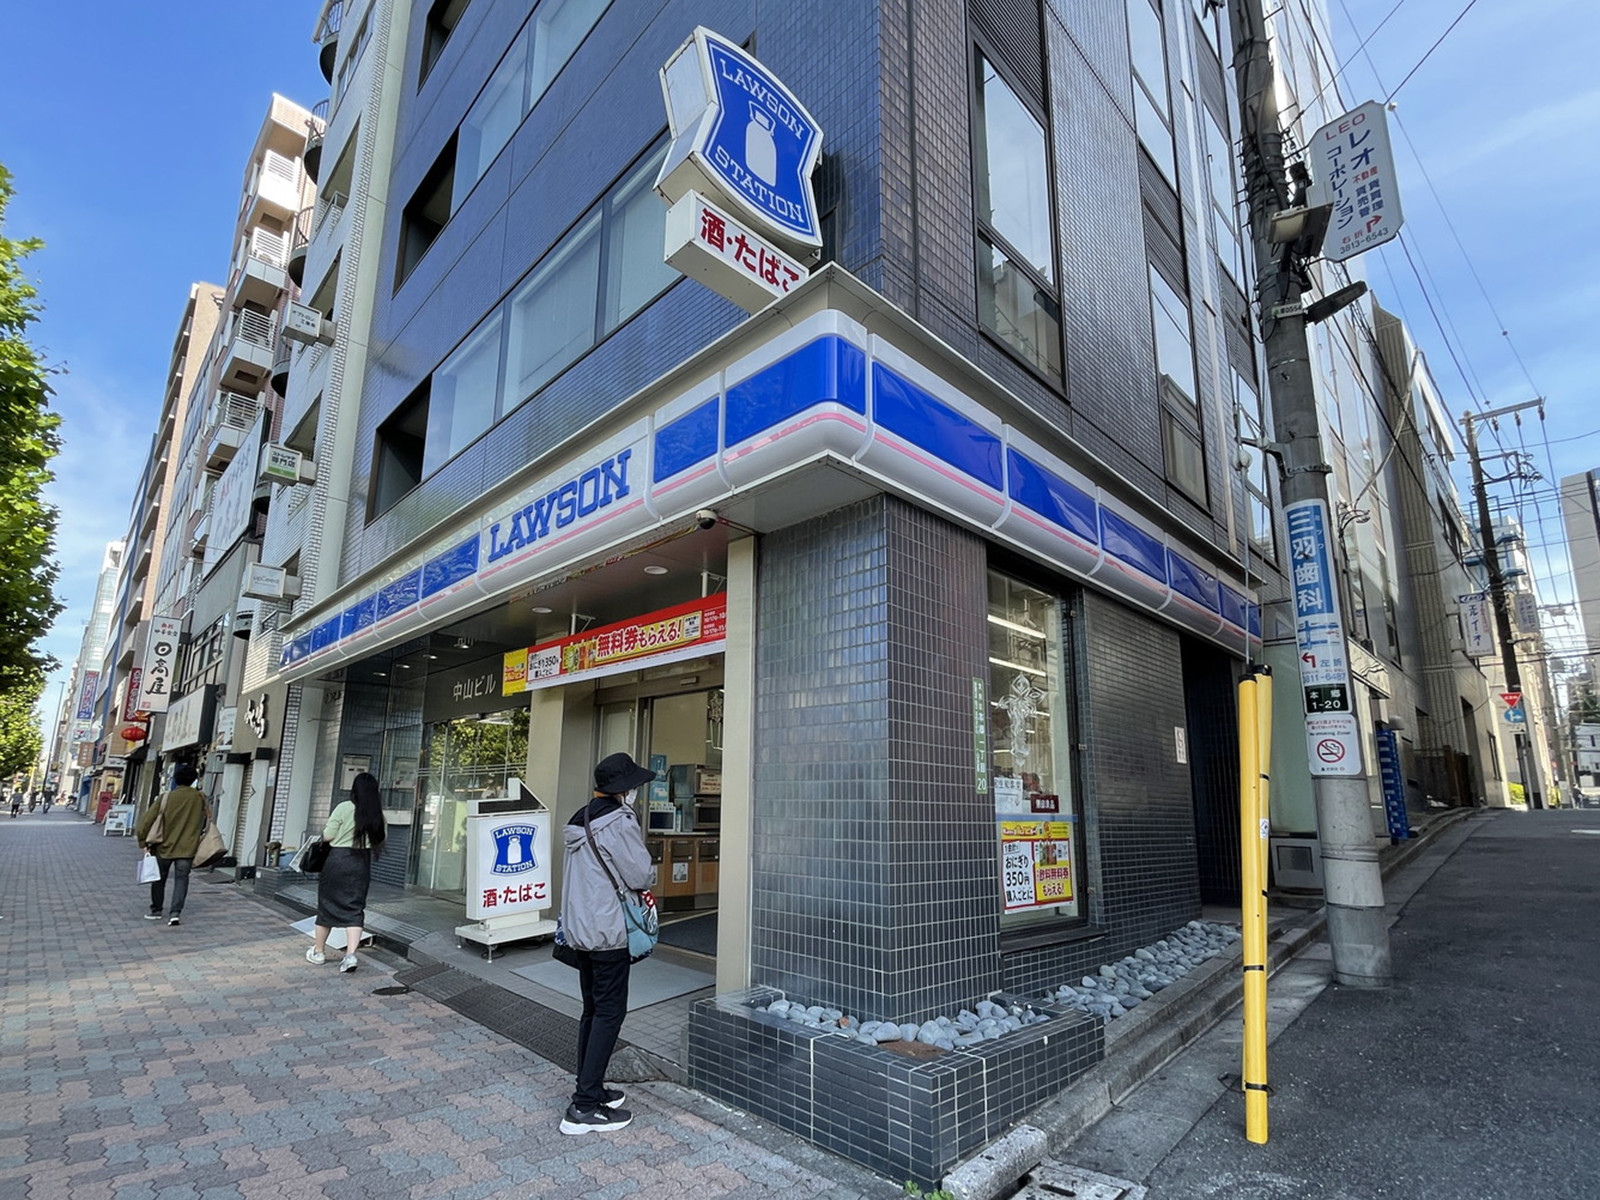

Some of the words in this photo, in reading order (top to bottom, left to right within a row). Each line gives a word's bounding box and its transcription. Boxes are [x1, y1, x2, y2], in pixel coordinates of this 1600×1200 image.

[719, 58, 804, 140] LAWSON
[1325, 112, 1366, 141] LEO
[1349, 129, 1375, 170] レオ
[714, 145, 805, 224] STATION
[1327, 145, 1354, 230] コーポレーション
[1352, 166, 1379, 184] 不動産
[1340, 228, 1389, 254] 3813-6543
[272, 456, 296, 468] 専門店
[488, 448, 632, 563] LAWSON
[1289, 510, 1323, 612] 三羽歯科
[145, 641, 173, 695] 日高屋
[453, 673, 497, 702] 中山ビル
[1309, 689, 1341, 700] 本郷
[1312, 699, 1341, 709] 1-20
[977, 778, 987, 790] 20
[495, 826, 534, 839] LAWSON
[495, 860, 533, 873] STATION
[1005, 855, 1029, 870] おにぎり
[1006, 871, 1030, 887] 350円
[482, 882, 546, 908] 酒・たばこ
[1006, 889, 1033, 902] 購入ごとに
